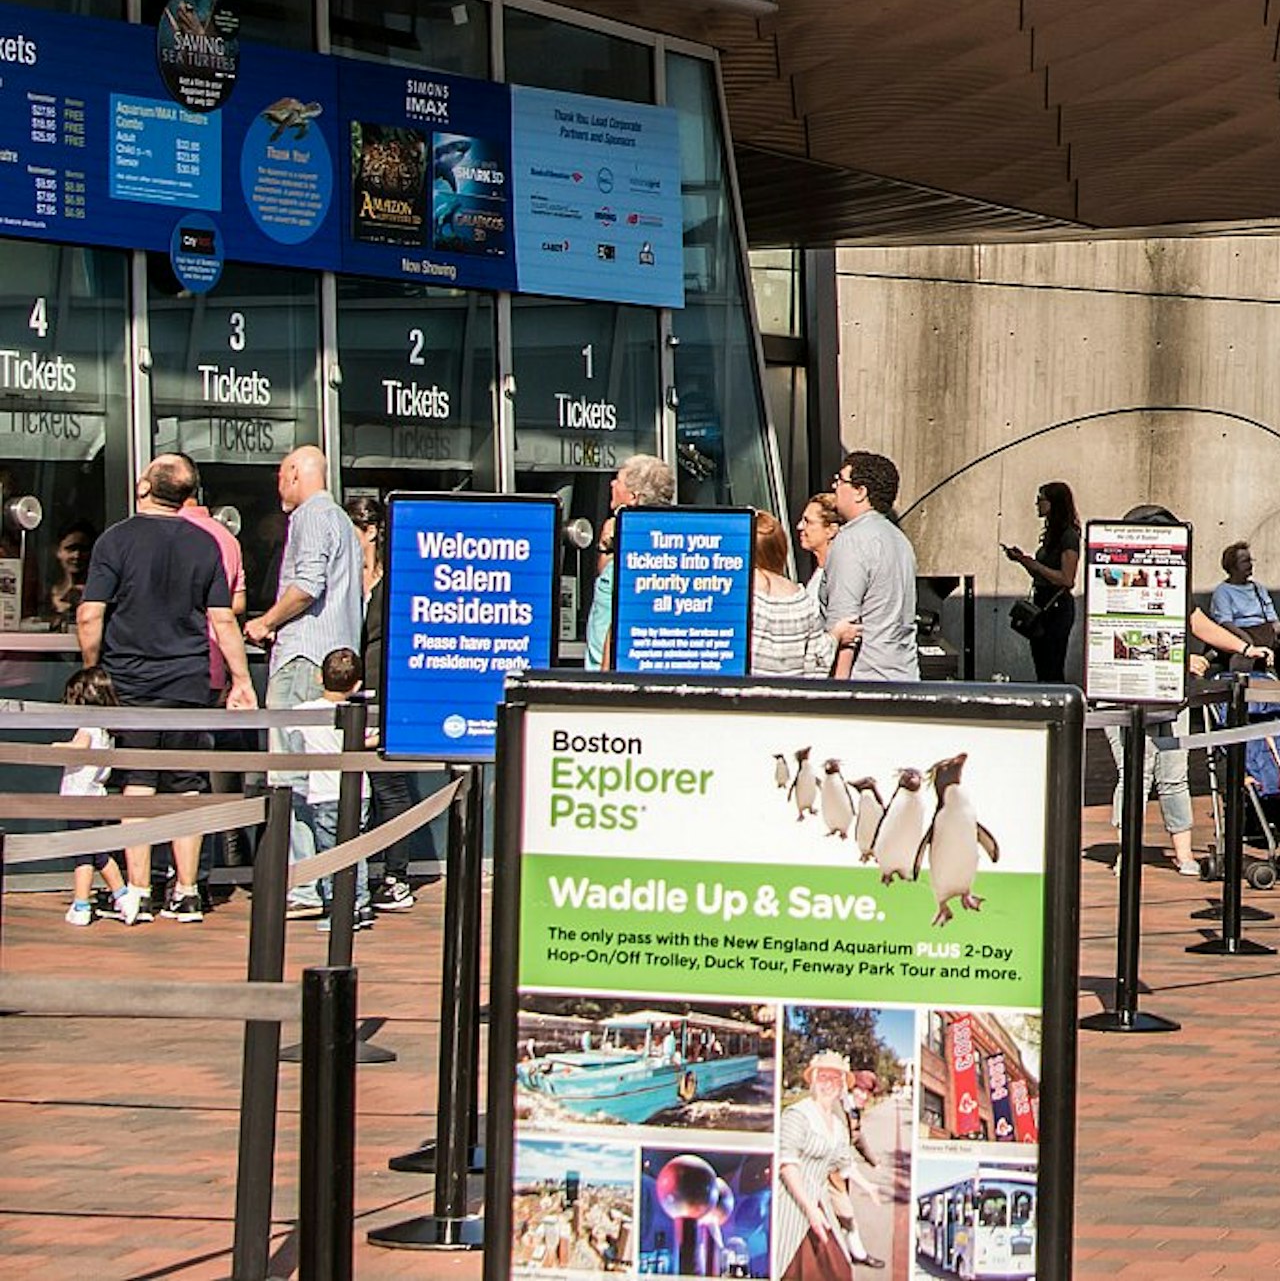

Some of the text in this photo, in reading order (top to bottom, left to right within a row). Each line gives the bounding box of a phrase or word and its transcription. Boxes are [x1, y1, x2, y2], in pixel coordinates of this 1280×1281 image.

[173, 31, 225, 56] SAVING
[162, 47, 236, 71] SEA TURTLES
[406, 79, 450, 99] SIMONS
[405, 96, 450, 117] IMAX
[115, 143, 136, 156] Child
[359, 190, 413, 219] AMAZON
[402, 258, 457, 279] Now Showing
[28, 297, 49, 337] 4
[229, 312, 246, 351] 3
[408, 328, 426, 366] 2
[581, 344, 594, 379] 1
[0, 349, 76, 393] Tickets
[197, 364, 271, 406] Tickets
[381, 379, 450, 419] Tickets
[554, 392, 617, 431] Tickets
[417, 531, 531, 561] Welcome
[649, 530, 722, 553] Turn your
[626, 552, 744, 570] tickets into free
[434, 564, 512, 593] Salem
[634, 573, 733, 595] priority entry
[411, 595, 533, 626] Residents
[652, 594, 714, 617] all year!
[412, 633, 530, 654] Please have proof
[409, 653, 532, 673] of residency ready.
[551, 729, 643, 757] Boston
[550, 756, 714, 798] Explorer
[549, 793, 639, 831] Pass
[547, 875, 886, 924] Waddle Up & Save.
[548, 926, 1013, 962] The only pass with the New England Aquarium PLUS 2-Day
[547, 948, 1022, 982] Hop-On/Off Trolley, Duck Tour, Fenway Park Tour and more.
